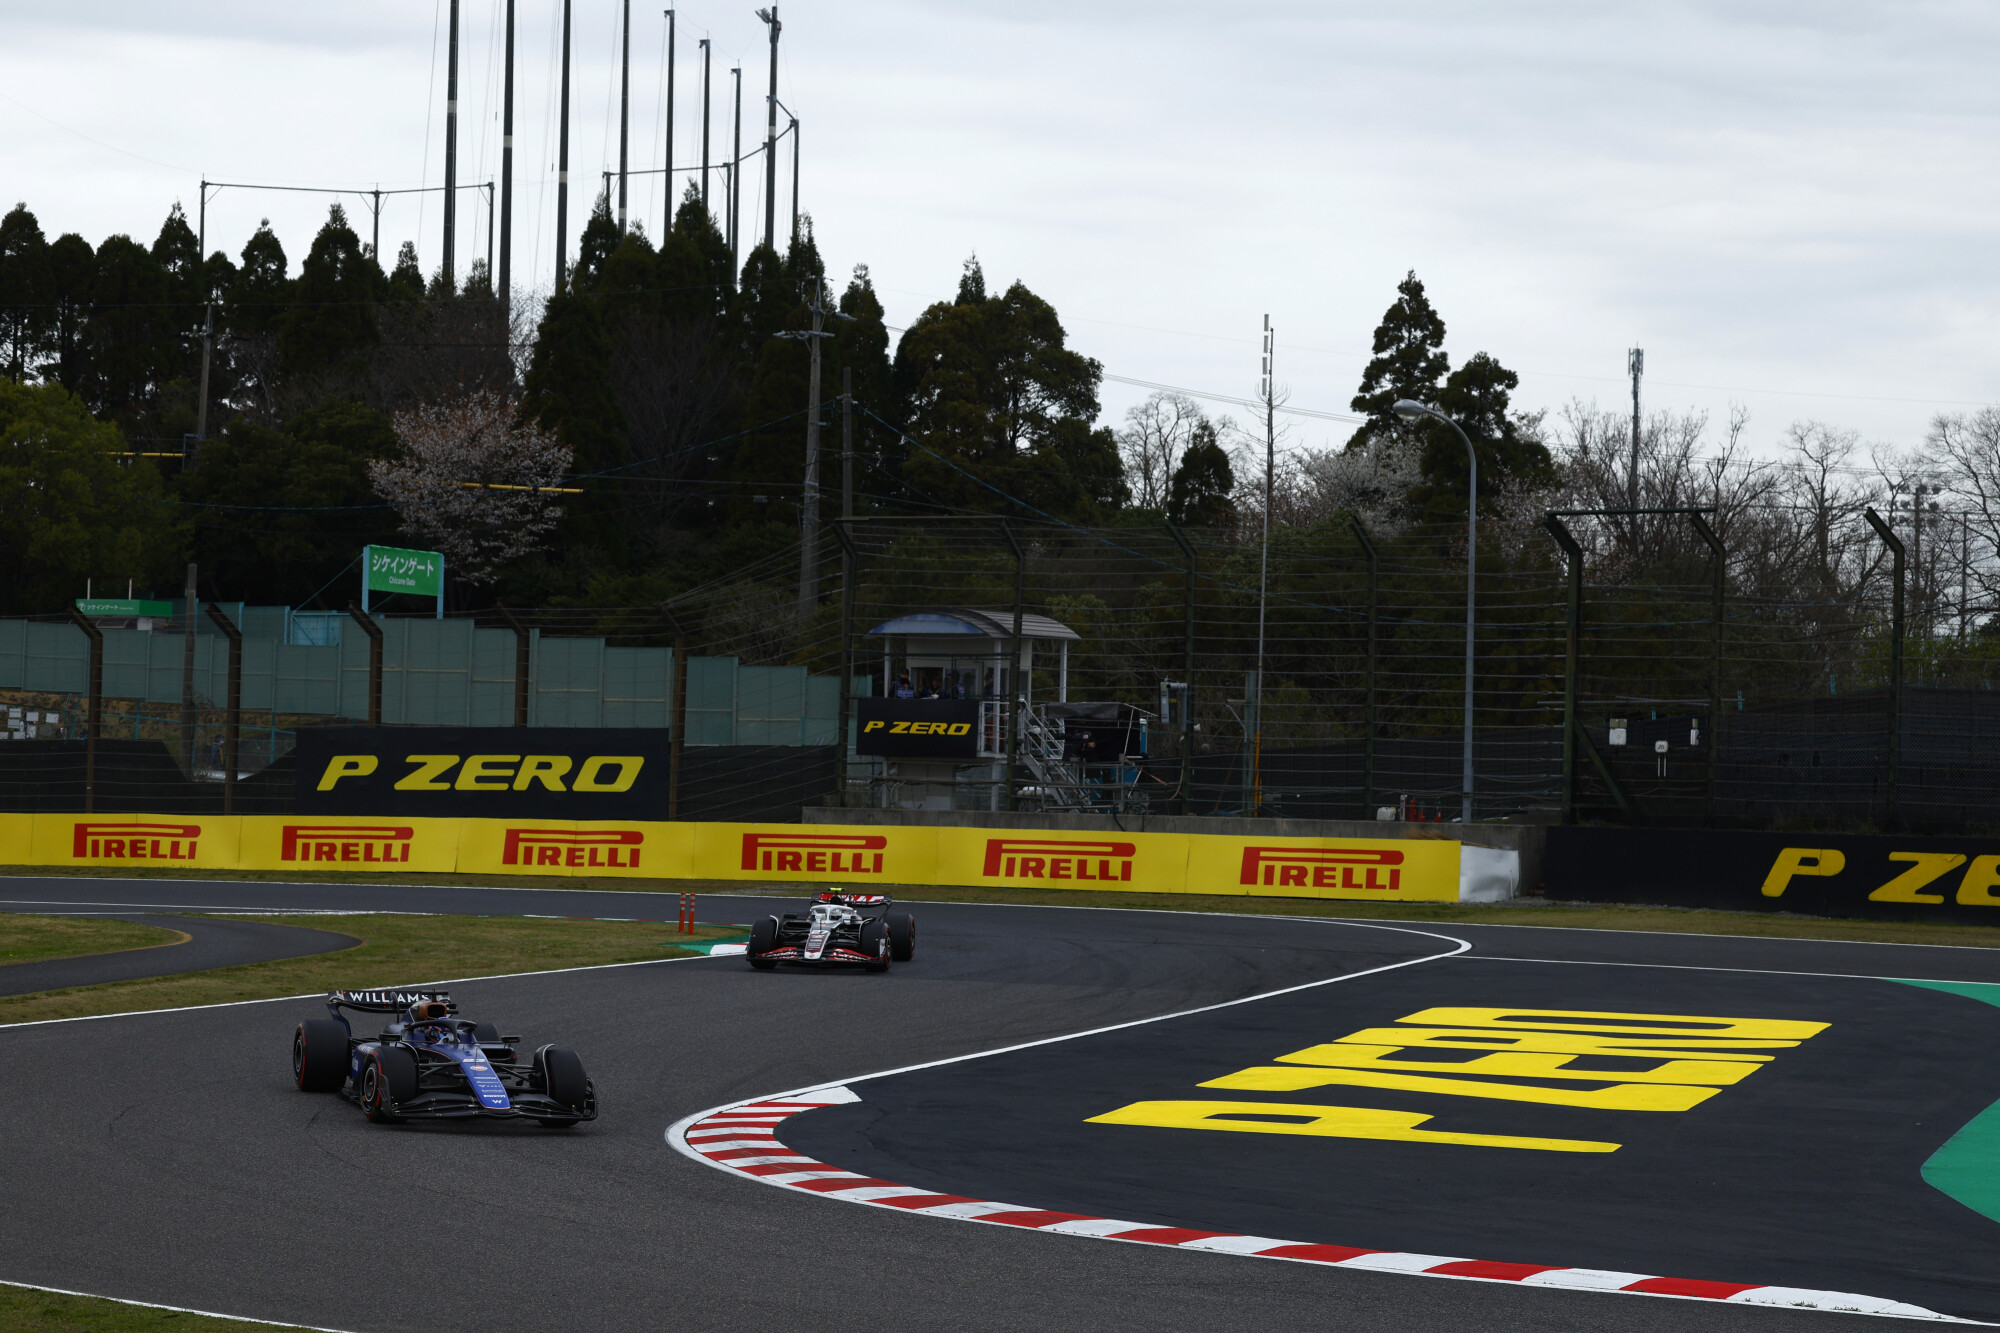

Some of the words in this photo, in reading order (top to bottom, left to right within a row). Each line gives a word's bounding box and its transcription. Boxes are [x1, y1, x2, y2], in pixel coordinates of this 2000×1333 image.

[372, 555, 434, 577] シケインゲート
[862, 720, 885, 733] P
[889, 721, 971, 736] ZERO
[316, 755, 379, 791] P
[393, 755, 645, 792] ZERO
[73, 823, 201, 859] PIRELLI
[281, 826, 414, 862] PIRELLI
[502, 829, 644, 868] PIRELLI
[741, 833, 887, 873] PIRELLI
[983, 839, 1136, 881] PIRELLI
[1240, 847, 1404, 890] PIRELLI
[1761, 847, 1846, 897] P
[349, 992, 430, 1003] WILLAMS
[1196, 1007, 1833, 1111] ZERO
